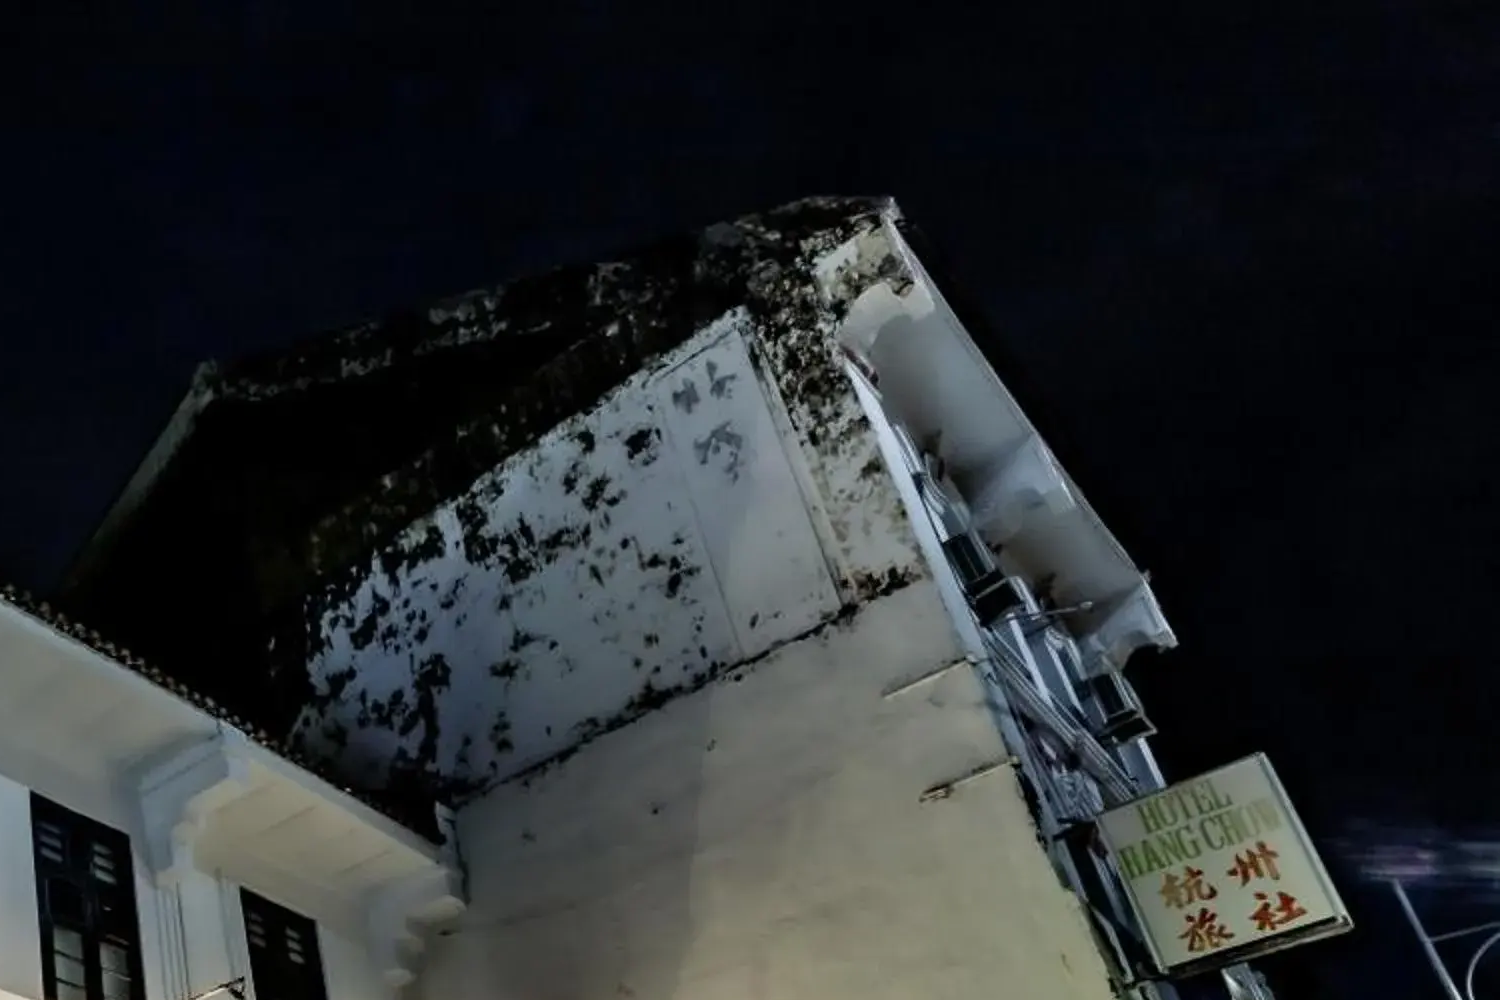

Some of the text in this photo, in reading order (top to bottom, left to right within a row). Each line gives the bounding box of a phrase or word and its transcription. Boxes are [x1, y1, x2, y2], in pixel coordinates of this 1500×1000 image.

[1136, 778, 1234, 834] HOTEL
[1158, 841, 1281, 911] 杭州
[1178, 890, 1308, 953] 旅社
